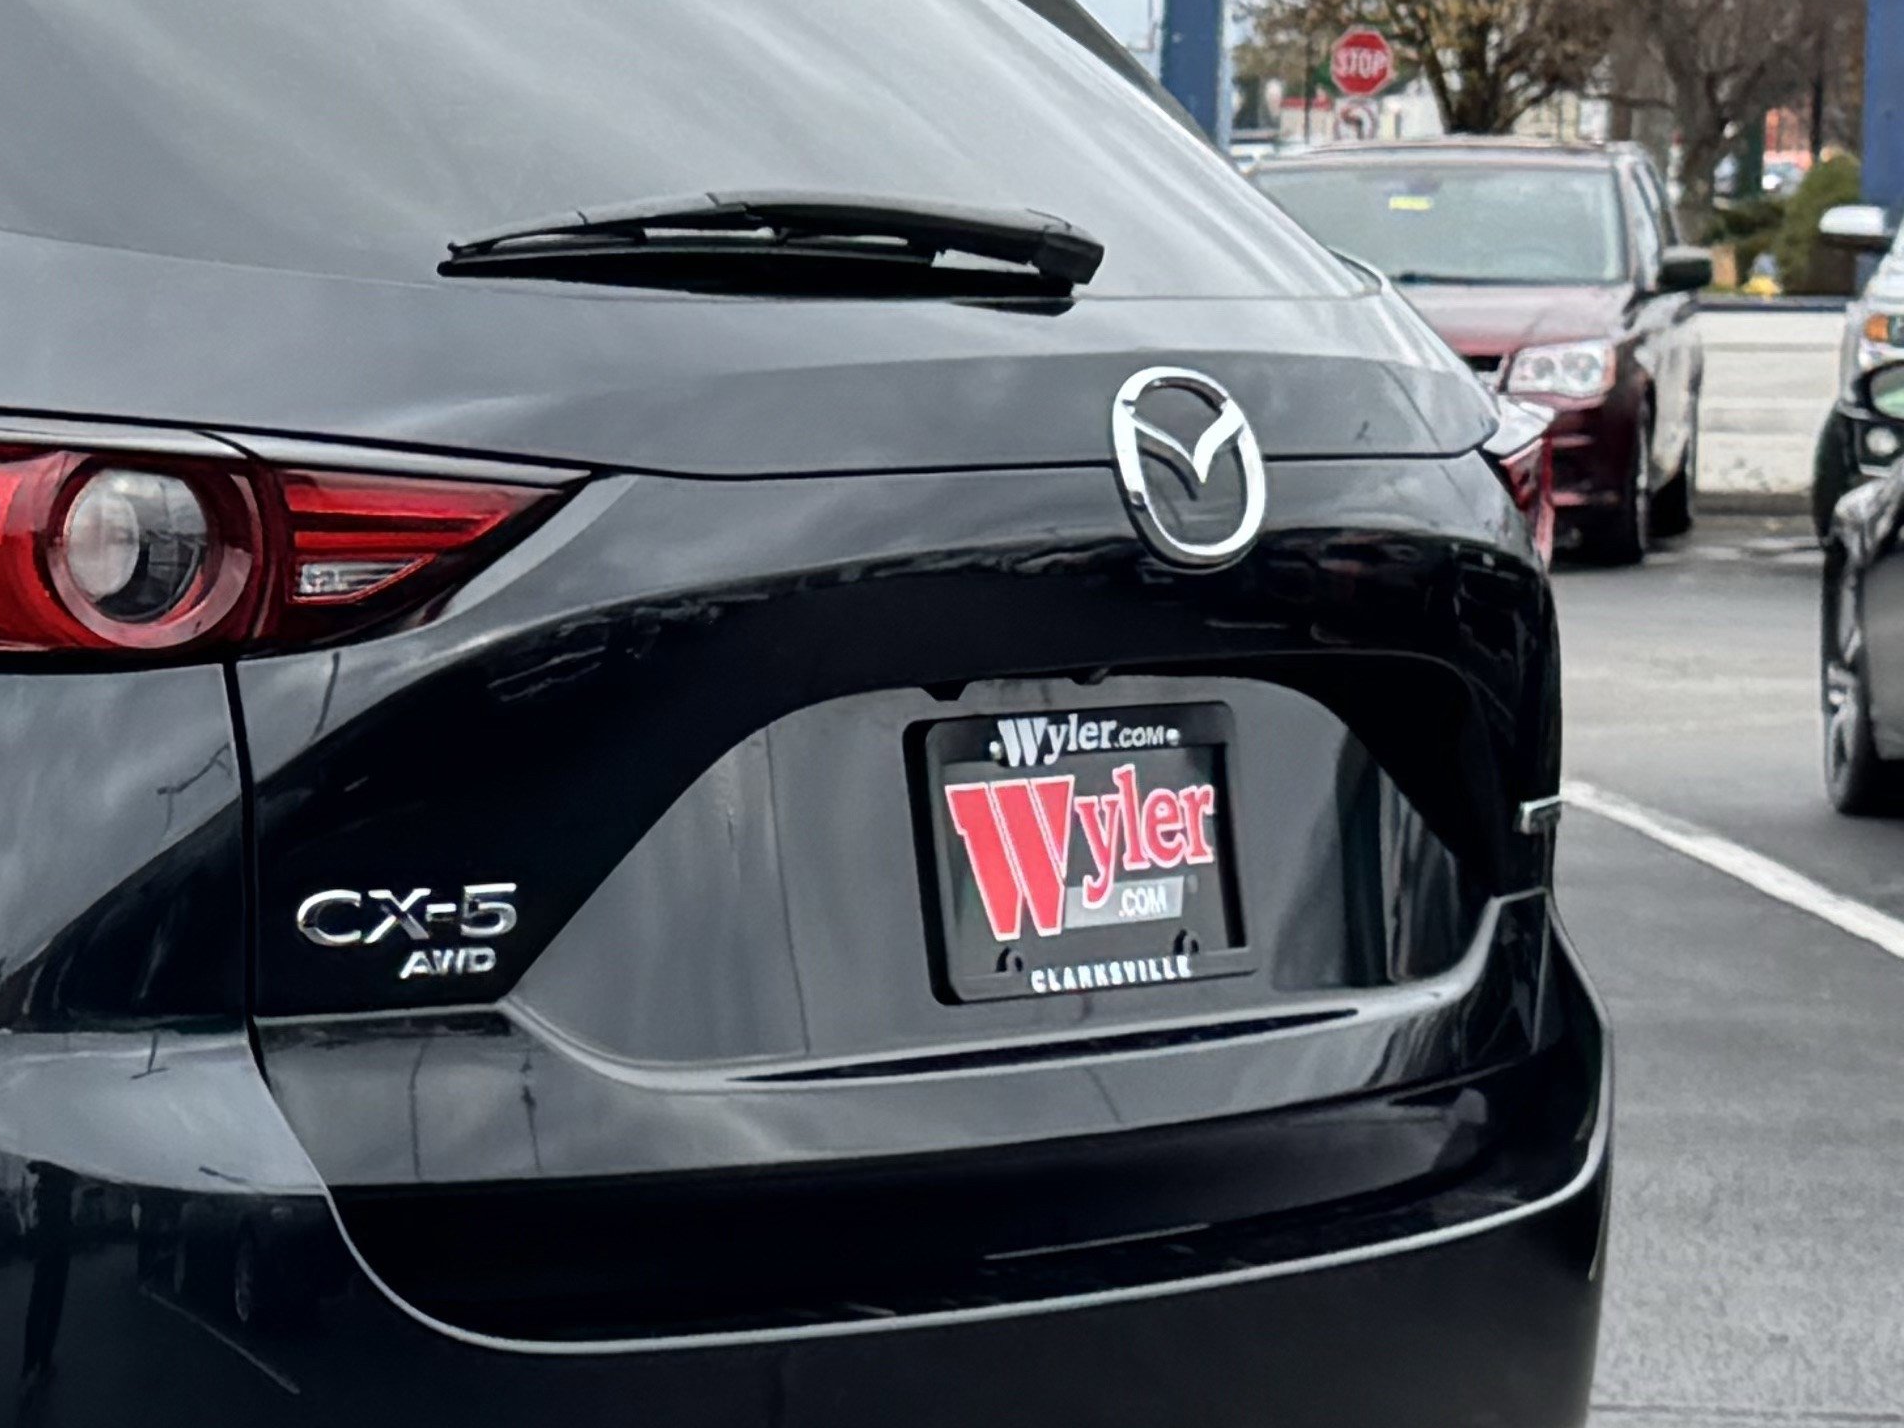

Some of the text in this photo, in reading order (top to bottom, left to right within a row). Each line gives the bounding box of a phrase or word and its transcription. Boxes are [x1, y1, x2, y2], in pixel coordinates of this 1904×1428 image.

[1334, 47, 1388, 79] STOP
[944, 763, 1214, 942] Wyler
[297, 882, 517, 947] CX-5
[399, 946, 497, 980] AWD
[1030, 954, 1193, 993] CLARKSVILLE
